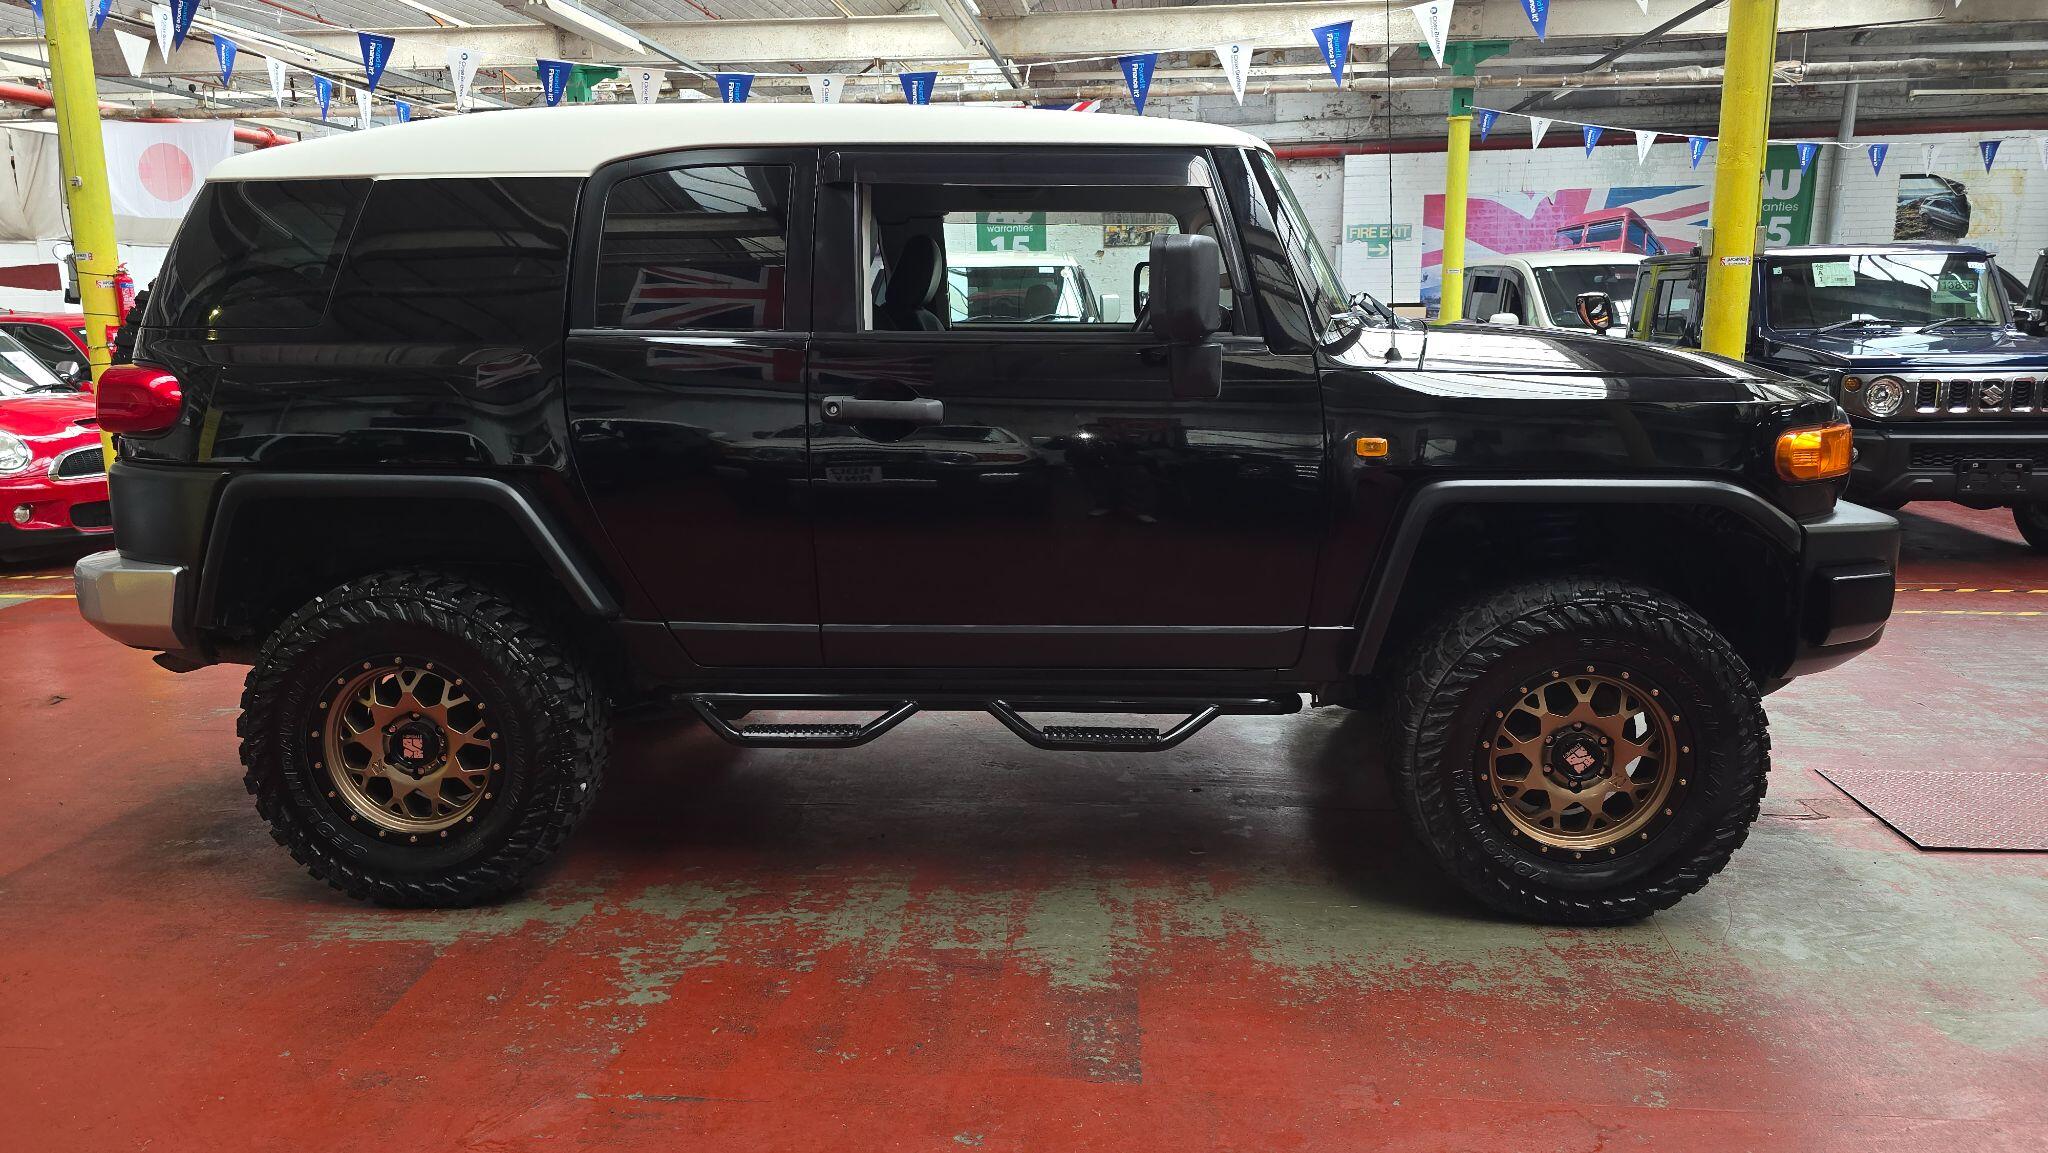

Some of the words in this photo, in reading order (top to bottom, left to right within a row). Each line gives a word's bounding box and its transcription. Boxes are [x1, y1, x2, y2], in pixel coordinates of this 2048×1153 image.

[1327, 33, 1335, 59] Finance
[1329, 59, 1337, 68] it?
[1762, 202, 1799, 212] anties
[986, 224, 1034, 233] warranties
[1349, 226, 1378, 239] FIRE
[1379, 225, 1411, 239] EXIT
[1765, 216, 1792, 247] 5
